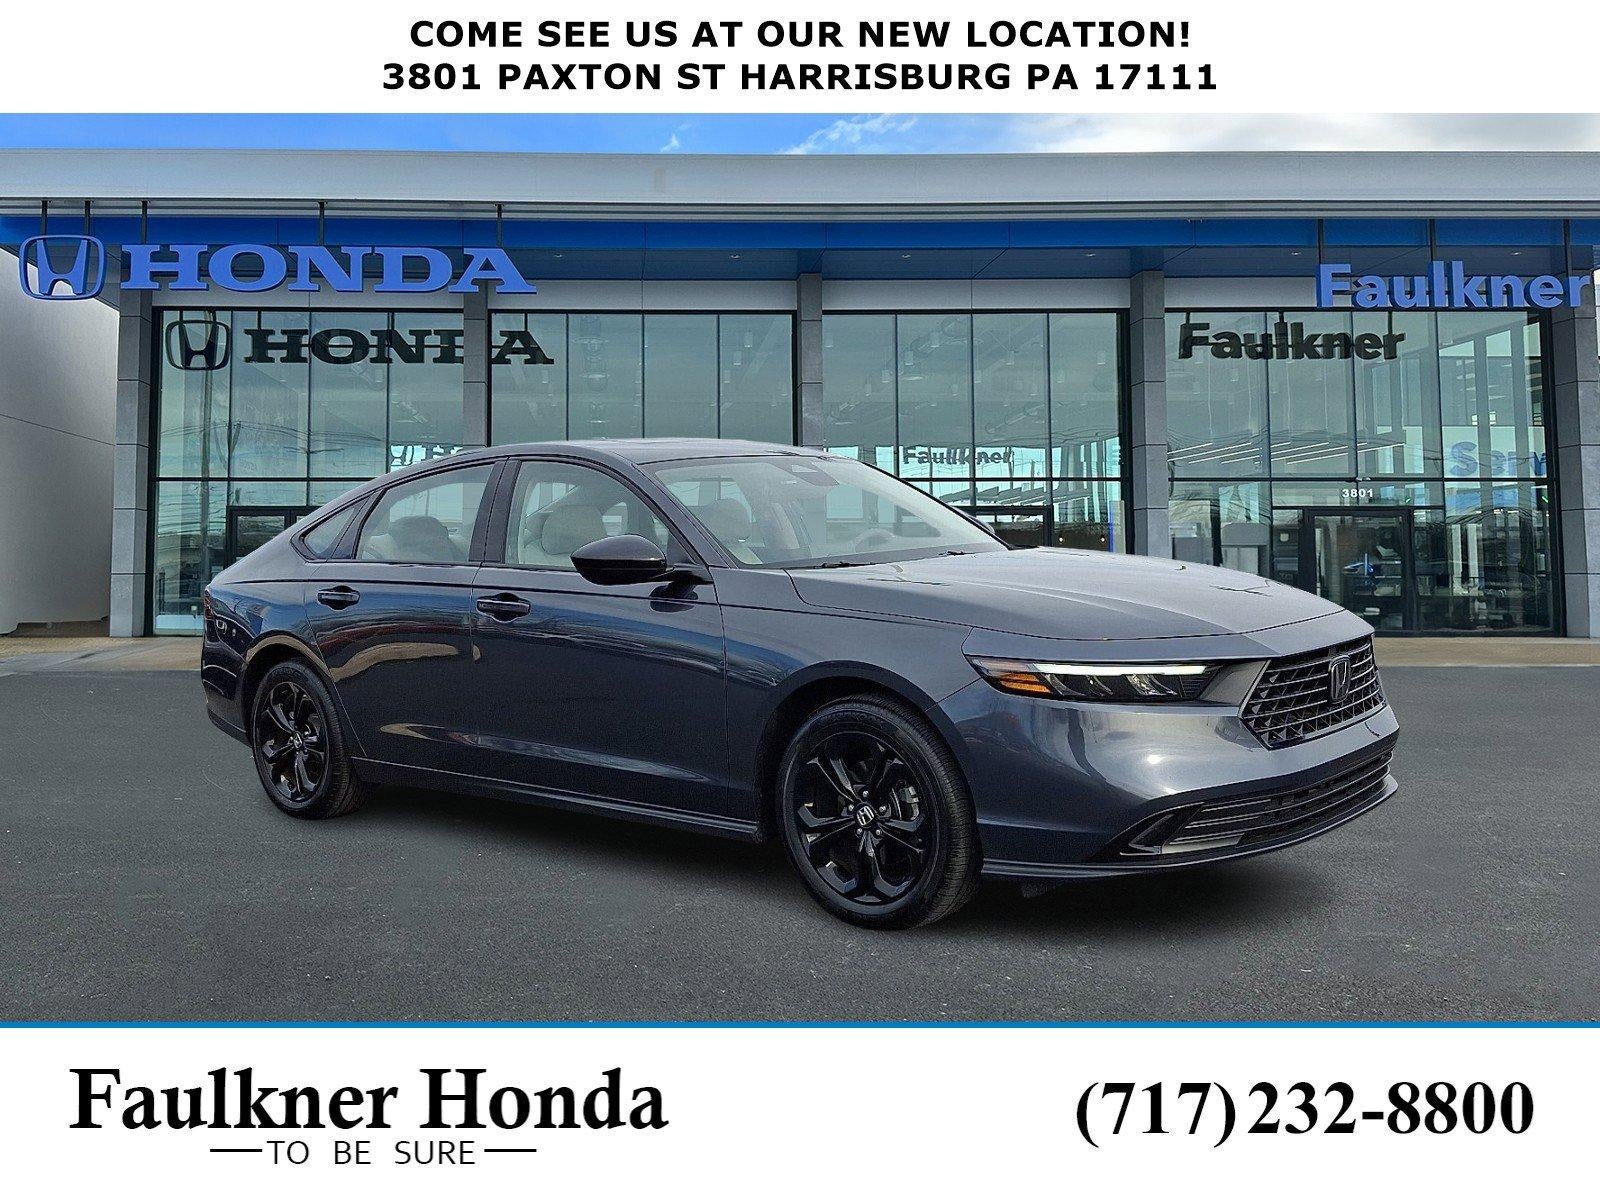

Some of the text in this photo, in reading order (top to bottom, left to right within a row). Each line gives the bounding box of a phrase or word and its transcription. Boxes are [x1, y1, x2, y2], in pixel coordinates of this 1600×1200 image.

[121, 244, 537, 294] HONDA
[1317, 260, 1590, 308] Faulkner
[1178, 322, 1405, 360] Faulkner
[1342, 488, 1373, 498] 3801
